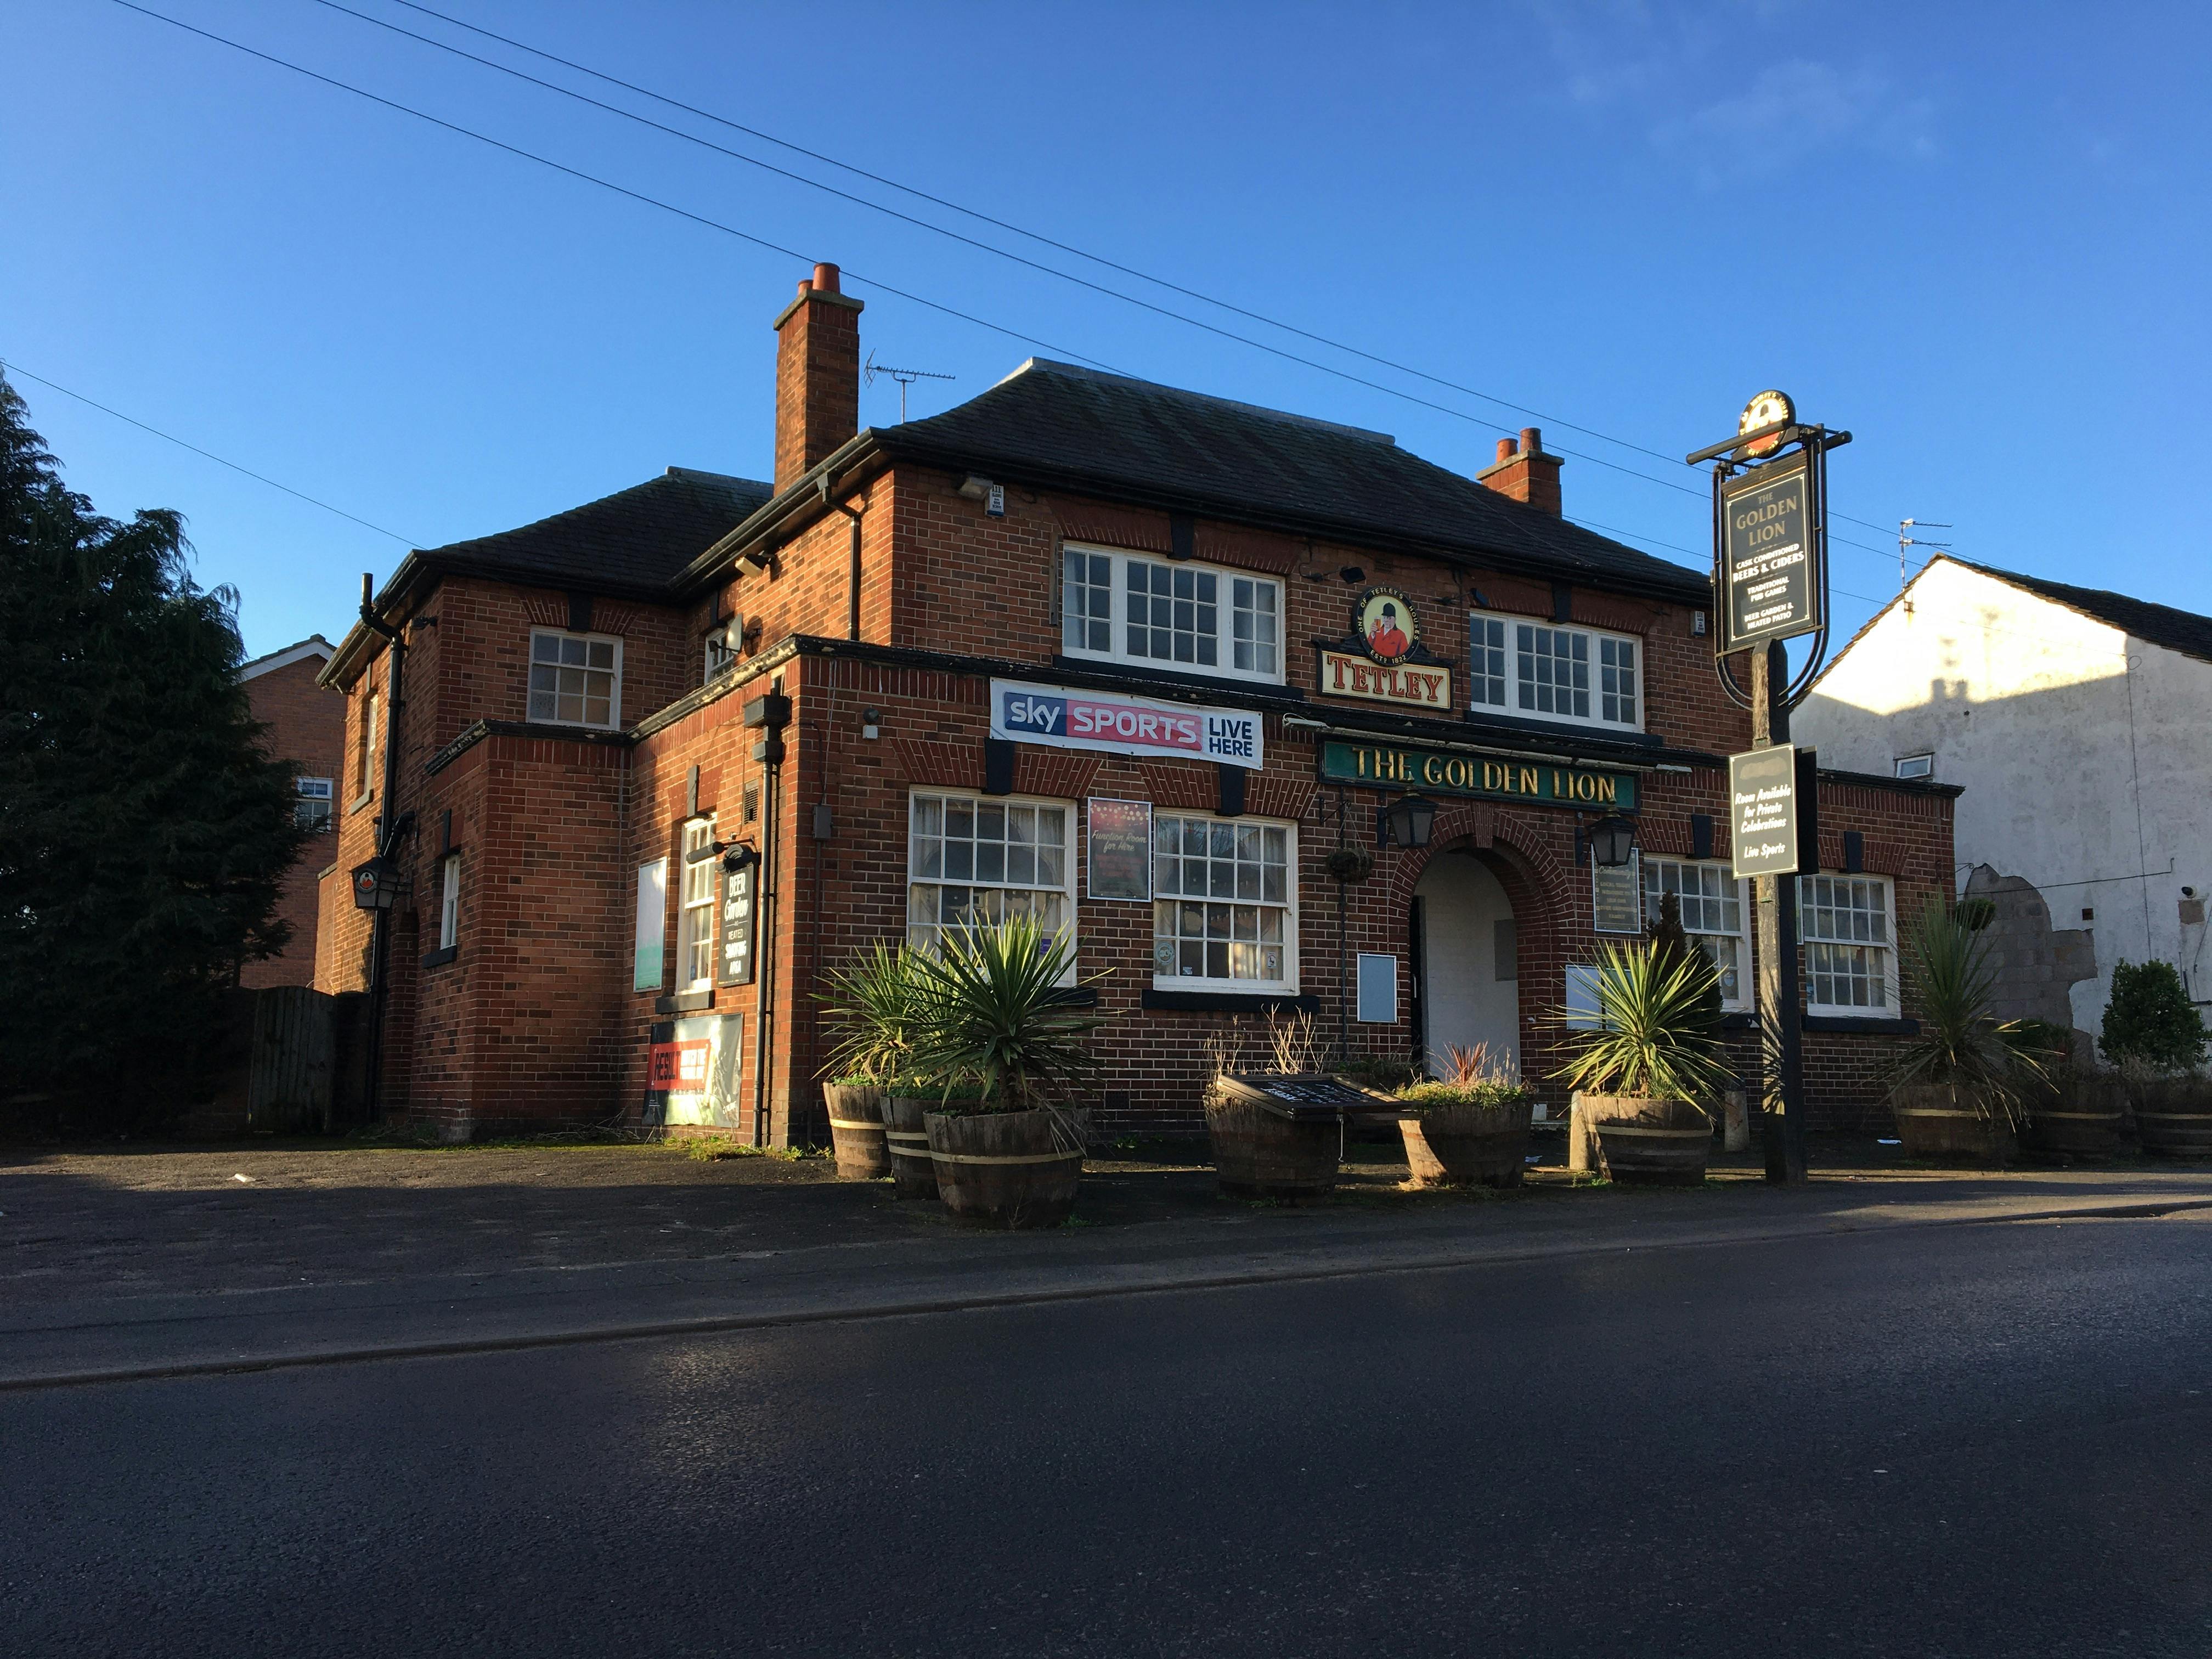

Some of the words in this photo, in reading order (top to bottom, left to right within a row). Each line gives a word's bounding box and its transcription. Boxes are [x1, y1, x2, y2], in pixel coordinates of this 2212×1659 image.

[1758, 492, 1774, 504] THE
[1736, 495, 1797, 529] GOLDEN
[1748, 521, 1785, 546] LION
[1736, 558, 1753, 569] CASK
[1753, 543, 1799, 564] CONDITIONED
[1733, 566, 1759, 583] BEERS
[1760, 563, 1770, 573] &
[1770, 551, 1804, 569] CIDERS
[1747, 576, 1790, 595] TRADITIONAL
[1751, 592, 1764, 602] PUB
[1764, 585, 1787, 597] GAMES
[1360, 597, 1367, 608] OF
[1408, 606, 1420, 640] HOUSES
[1744, 612, 1760, 622] BEER
[1760, 603, 1787, 617] GARDEN
[1747, 617, 1771, 630] HEATED
[1772, 611, 1792, 622] PATIO
[1391, 654, 1407, 664] 1822
[1328, 655, 1443, 701] TETLEY
[1010, 697, 1060, 732] sky
[1073, 707, 1196, 743] SPORTS
[1209, 717, 1252, 740] LIVE
[1209, 740, 1252, 757] HERE
[1352, 747, 1413, 782] THE
[1424, 756, 1538, 796] GOLDEN
[1553, 770, 1616, 804] LION
[1735, 792, 1756, 805] Room
[1757, 784, 1791, 802] Available
[1744, 805, 1756, 818] for
[1757, 802, 1782, 816] Private
[1741, 817, 1787, 833] Celebrations
[1091, 830, 1124, 842] Function
[1126, 832, 1147, 843] Room
[1103, 840, 1116, 853] for
[1743, 845, 1759, 859] Live
[1760, 843, 1786, 859] Sports
[729, 872, 746, 898] BEER
[728, 928, 743, 940] HEATED
[729, 960, 742, 975] AREA
